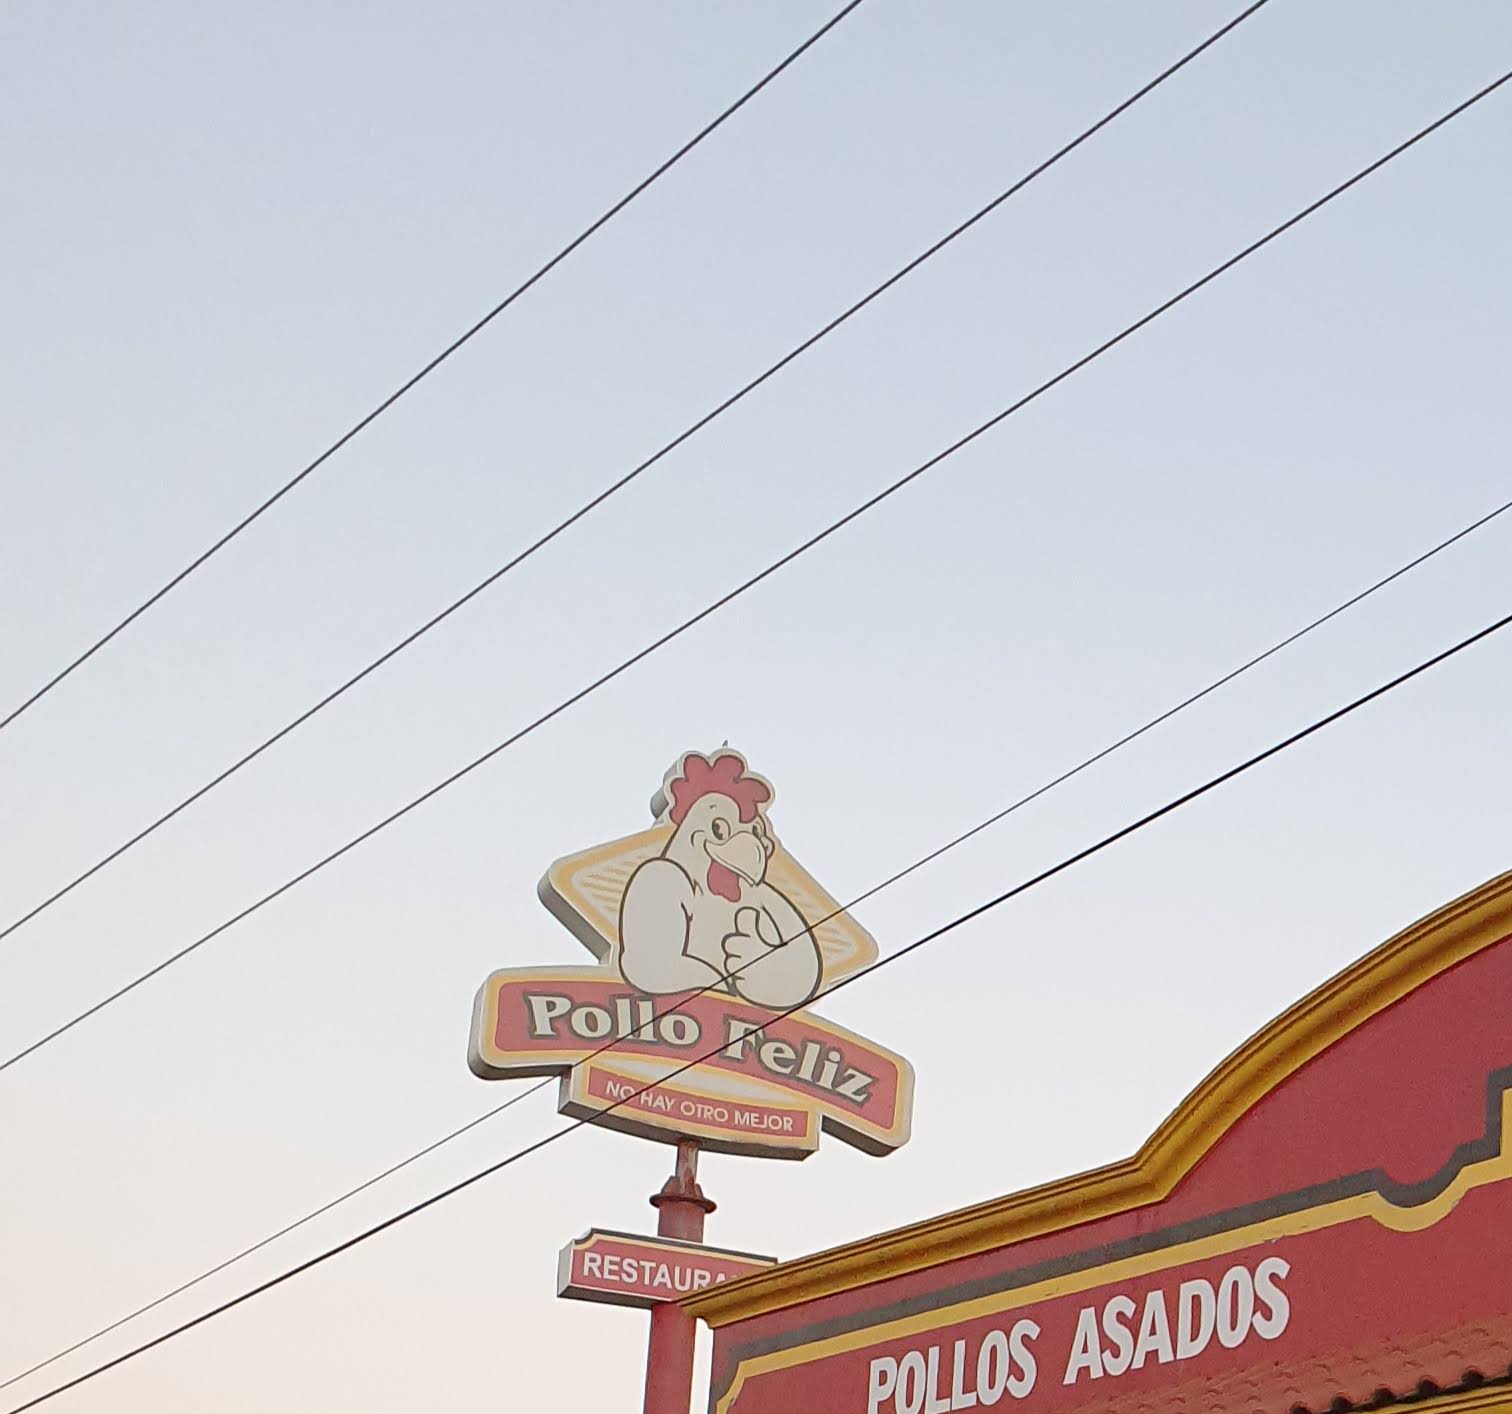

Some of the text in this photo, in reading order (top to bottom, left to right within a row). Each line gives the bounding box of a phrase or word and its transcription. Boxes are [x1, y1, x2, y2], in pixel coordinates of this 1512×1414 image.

[525, 993, 874, 1103] Pollo Feliz
[605, 1081, 793, 1131] NO HAY OTRO MEJOR
[1062, 1256, 1291, 1386] ASADOS
